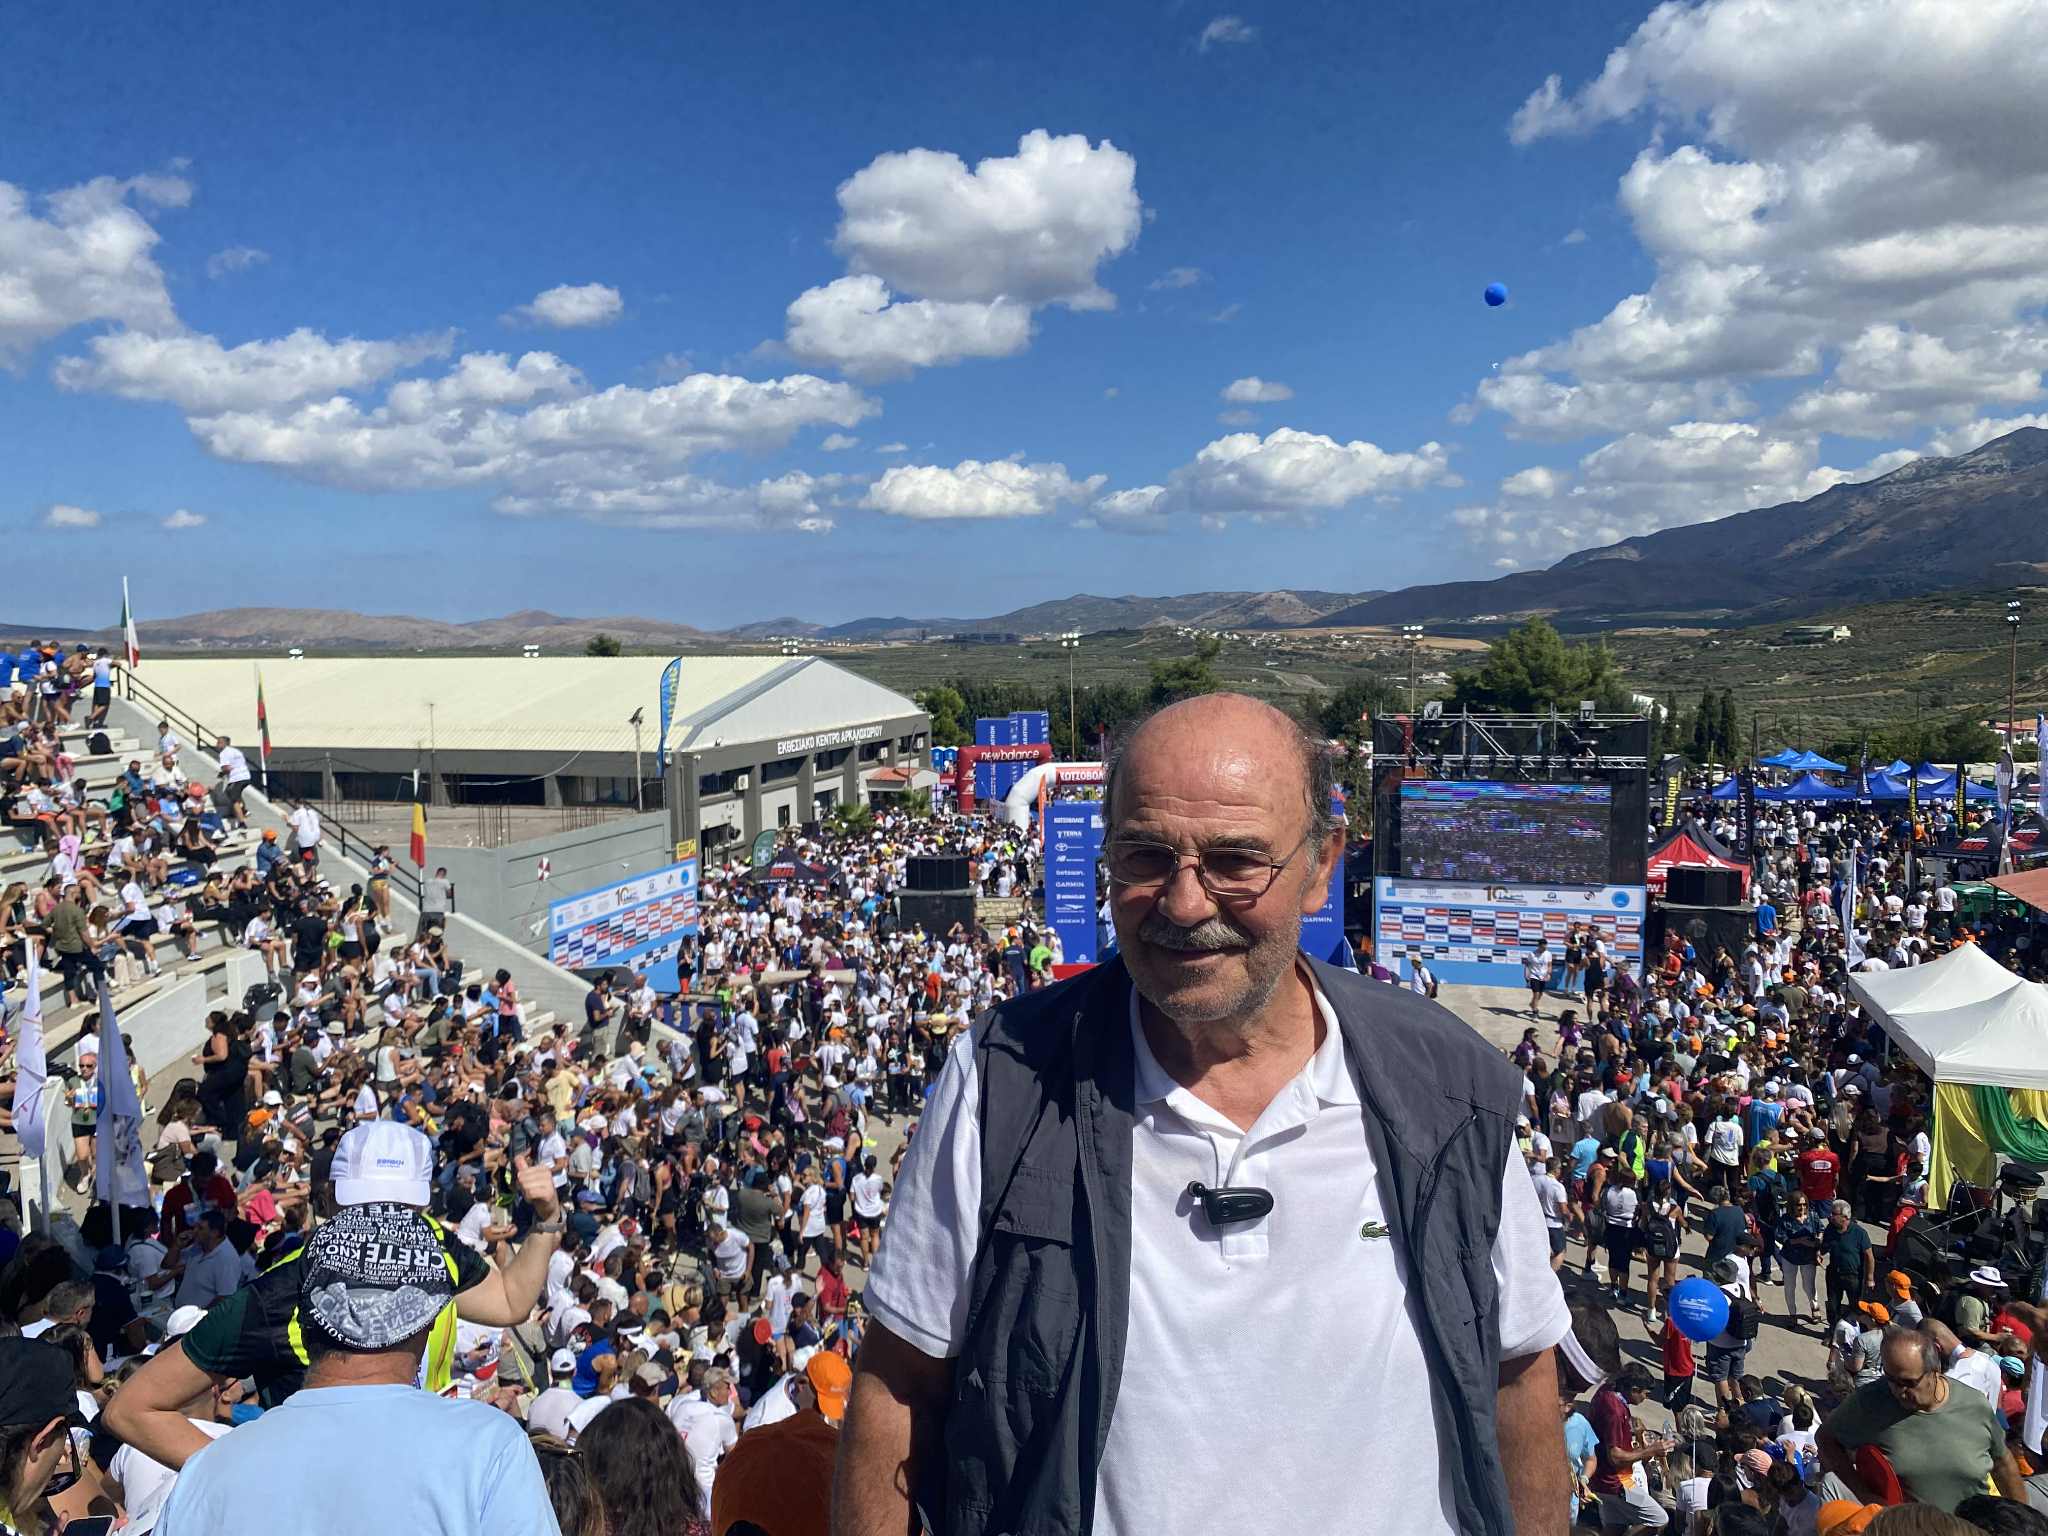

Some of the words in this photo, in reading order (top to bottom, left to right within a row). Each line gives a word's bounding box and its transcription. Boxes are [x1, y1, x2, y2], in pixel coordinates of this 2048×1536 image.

[815, 732, 840, 748] ΚΕΝΤΡΟ
[1663, 776, 1679, 827] boutique
[615, 887, 629, 906] 10
[332, 1232, 377, 1243] ARKAL
[325, 1244, 361, 1261] KNO
[365, 1243, 446, 1270] CRETE
[309, 1307, 343, 1342] FESTOS
